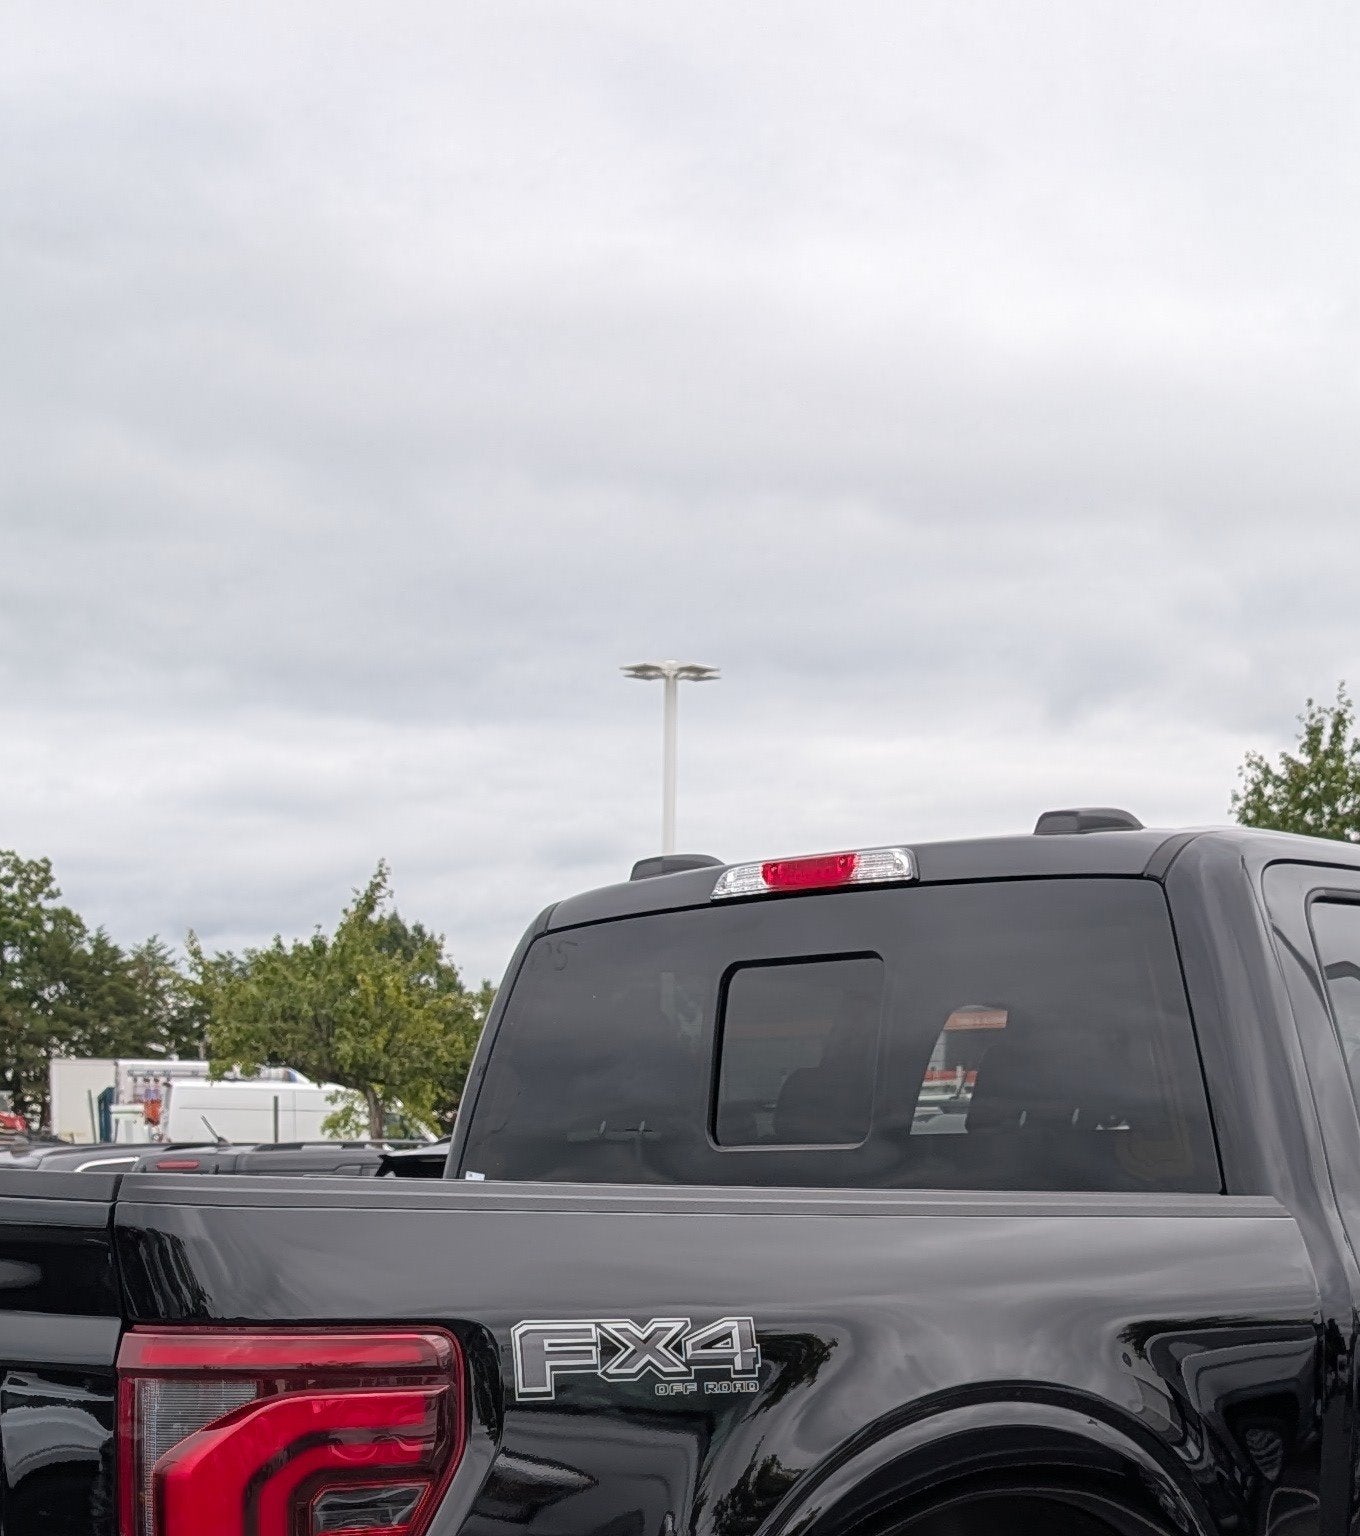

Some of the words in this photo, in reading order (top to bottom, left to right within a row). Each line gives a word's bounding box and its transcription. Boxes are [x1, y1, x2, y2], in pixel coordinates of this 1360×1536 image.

[510, 1317, 761, 1401] FX4
[654, 1382, 697, 1396] OFF
[703, 1380, 760, 1394] ROAD
